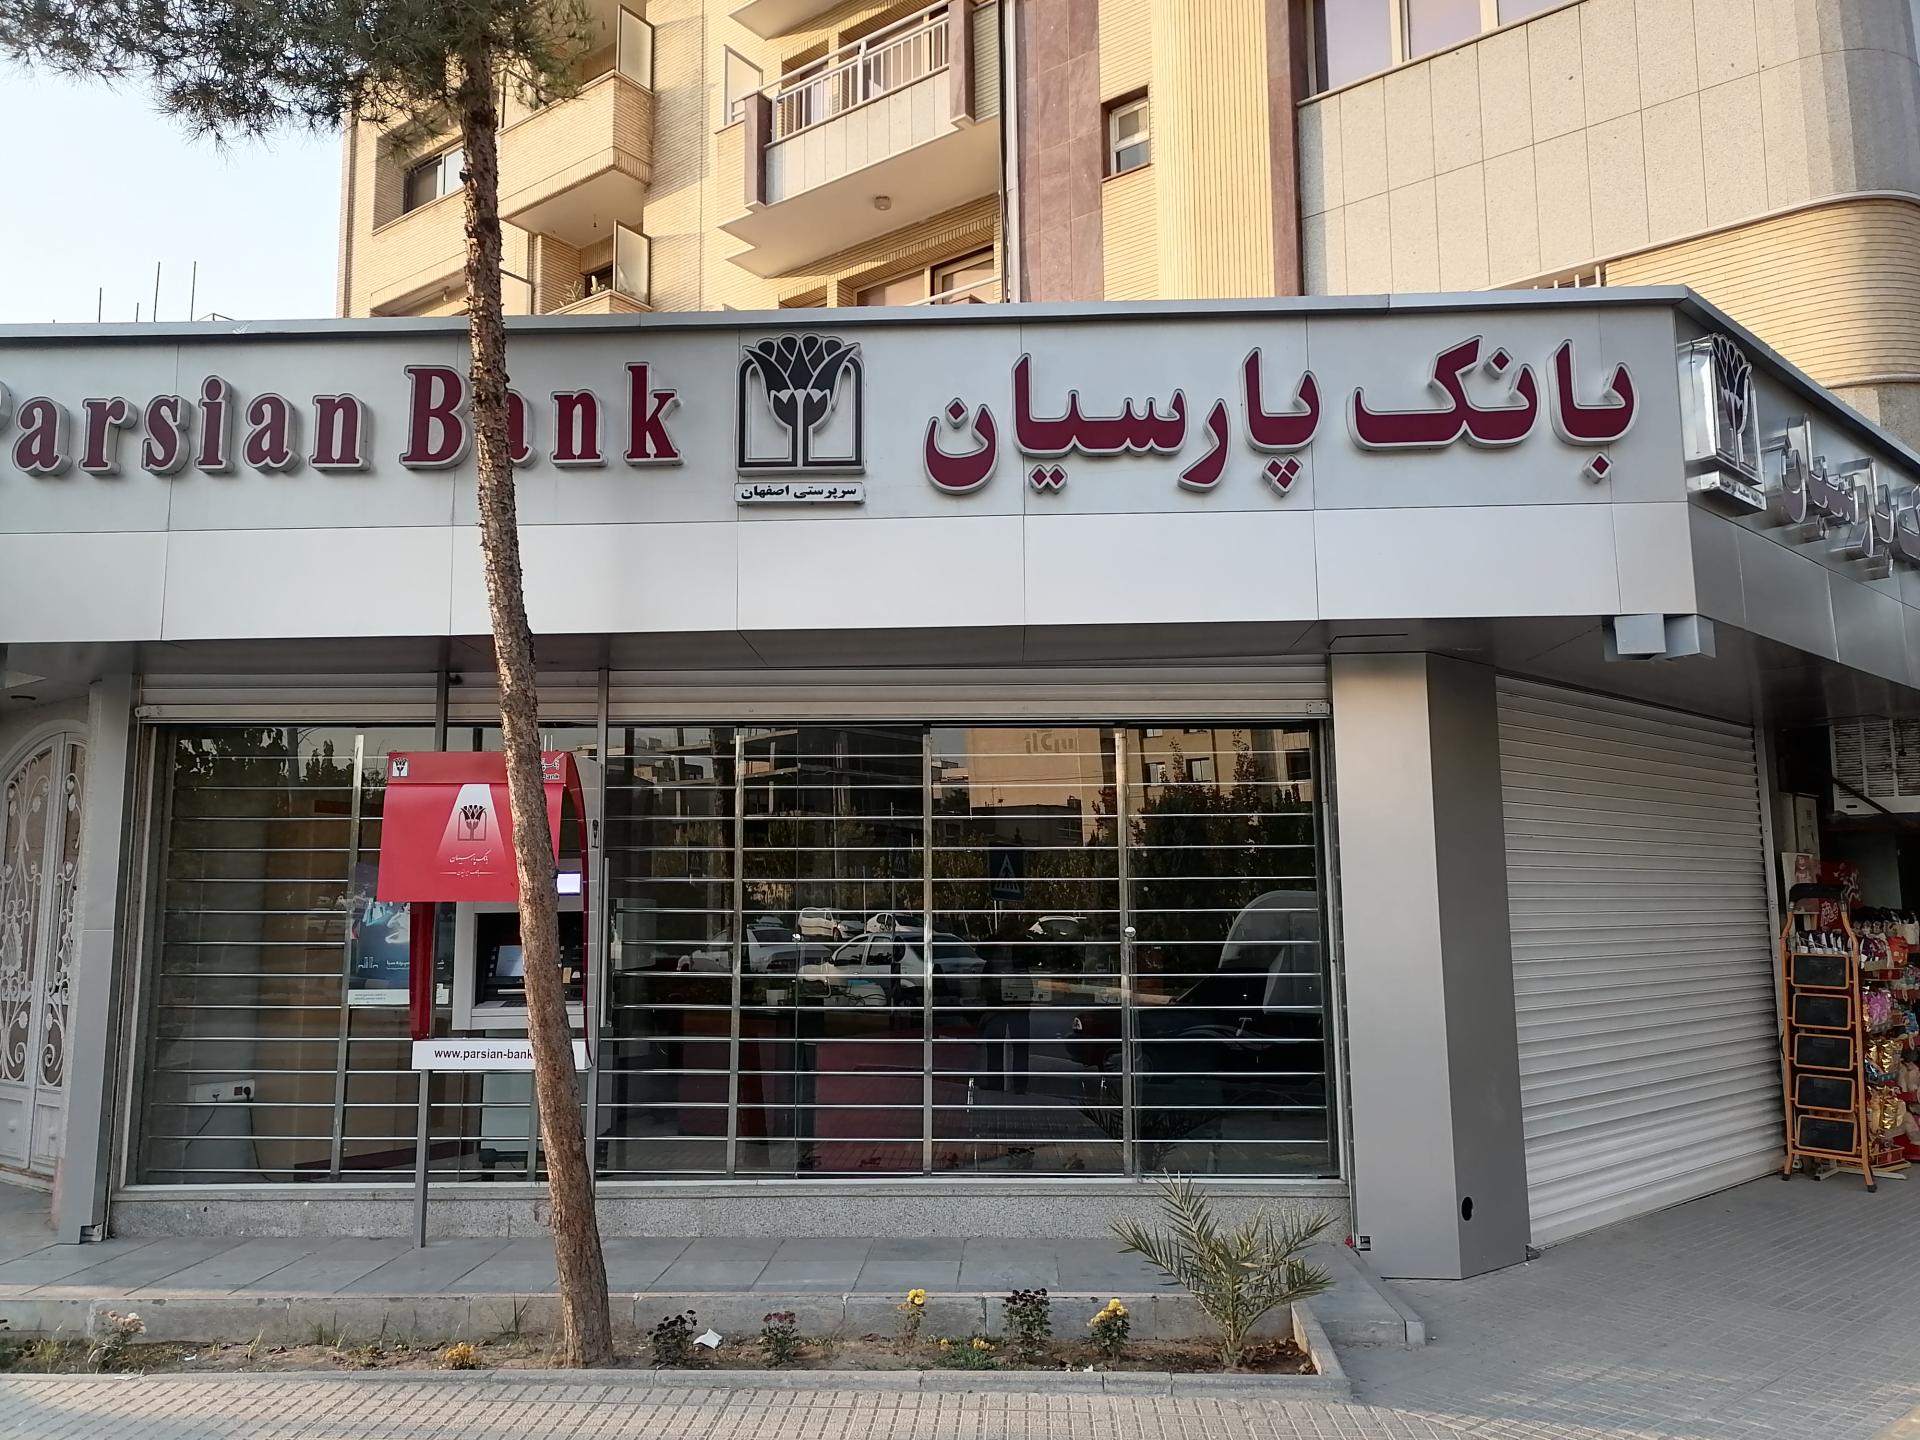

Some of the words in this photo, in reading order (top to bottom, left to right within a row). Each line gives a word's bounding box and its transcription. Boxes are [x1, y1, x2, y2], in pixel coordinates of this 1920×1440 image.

[0, 373, 370, 476] arsian
[922, 346, 1325, 497] پارسیان
[1346, 335, 1640, 484] بانک
[740, 484, 790, 500] اصفهان
[791, 486, 857, 499] سرپرستی
